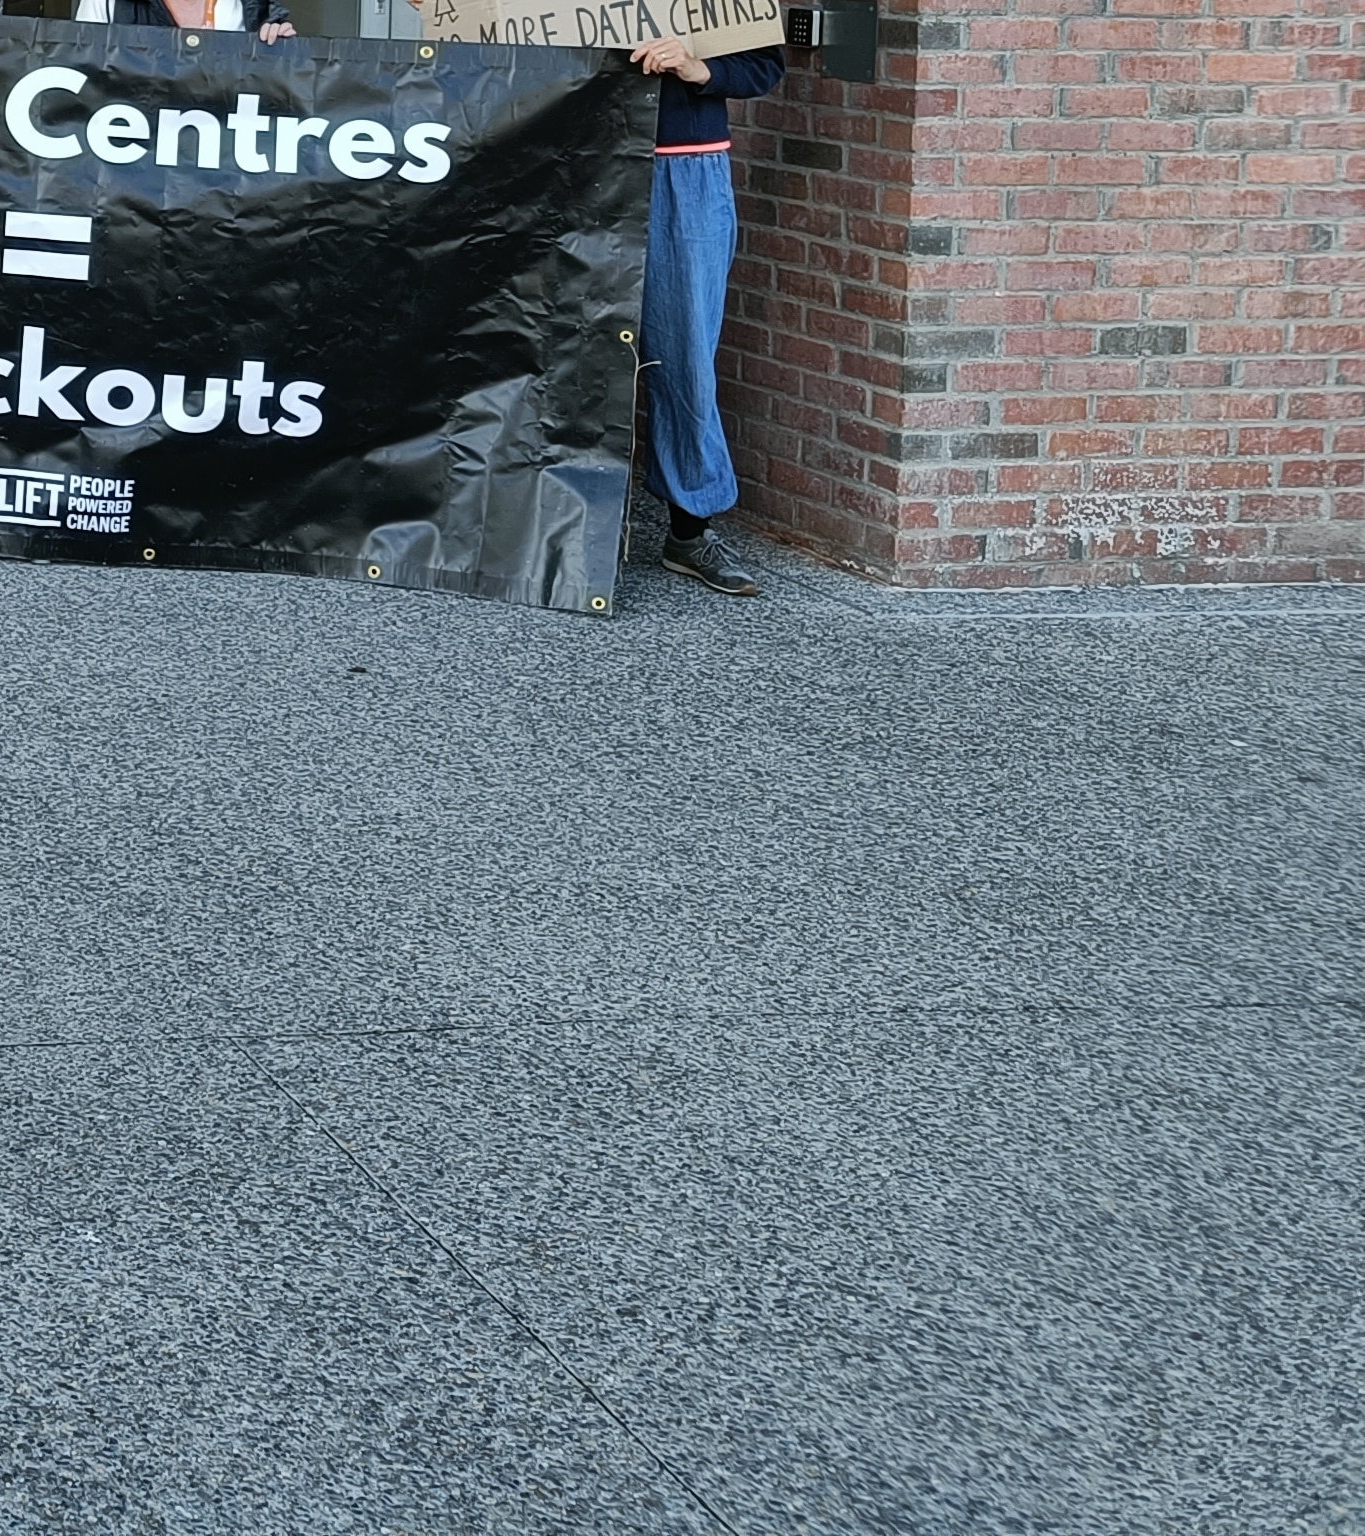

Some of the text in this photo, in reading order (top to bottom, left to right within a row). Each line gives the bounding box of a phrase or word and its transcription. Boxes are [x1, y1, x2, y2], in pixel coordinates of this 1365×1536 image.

[5, 66, 452, 184] Centres
[69, 474, 135, 498] PEOPLE
[67, 496, 132, 514] POWERED
[66, 514, 131, 534] CHANGE
